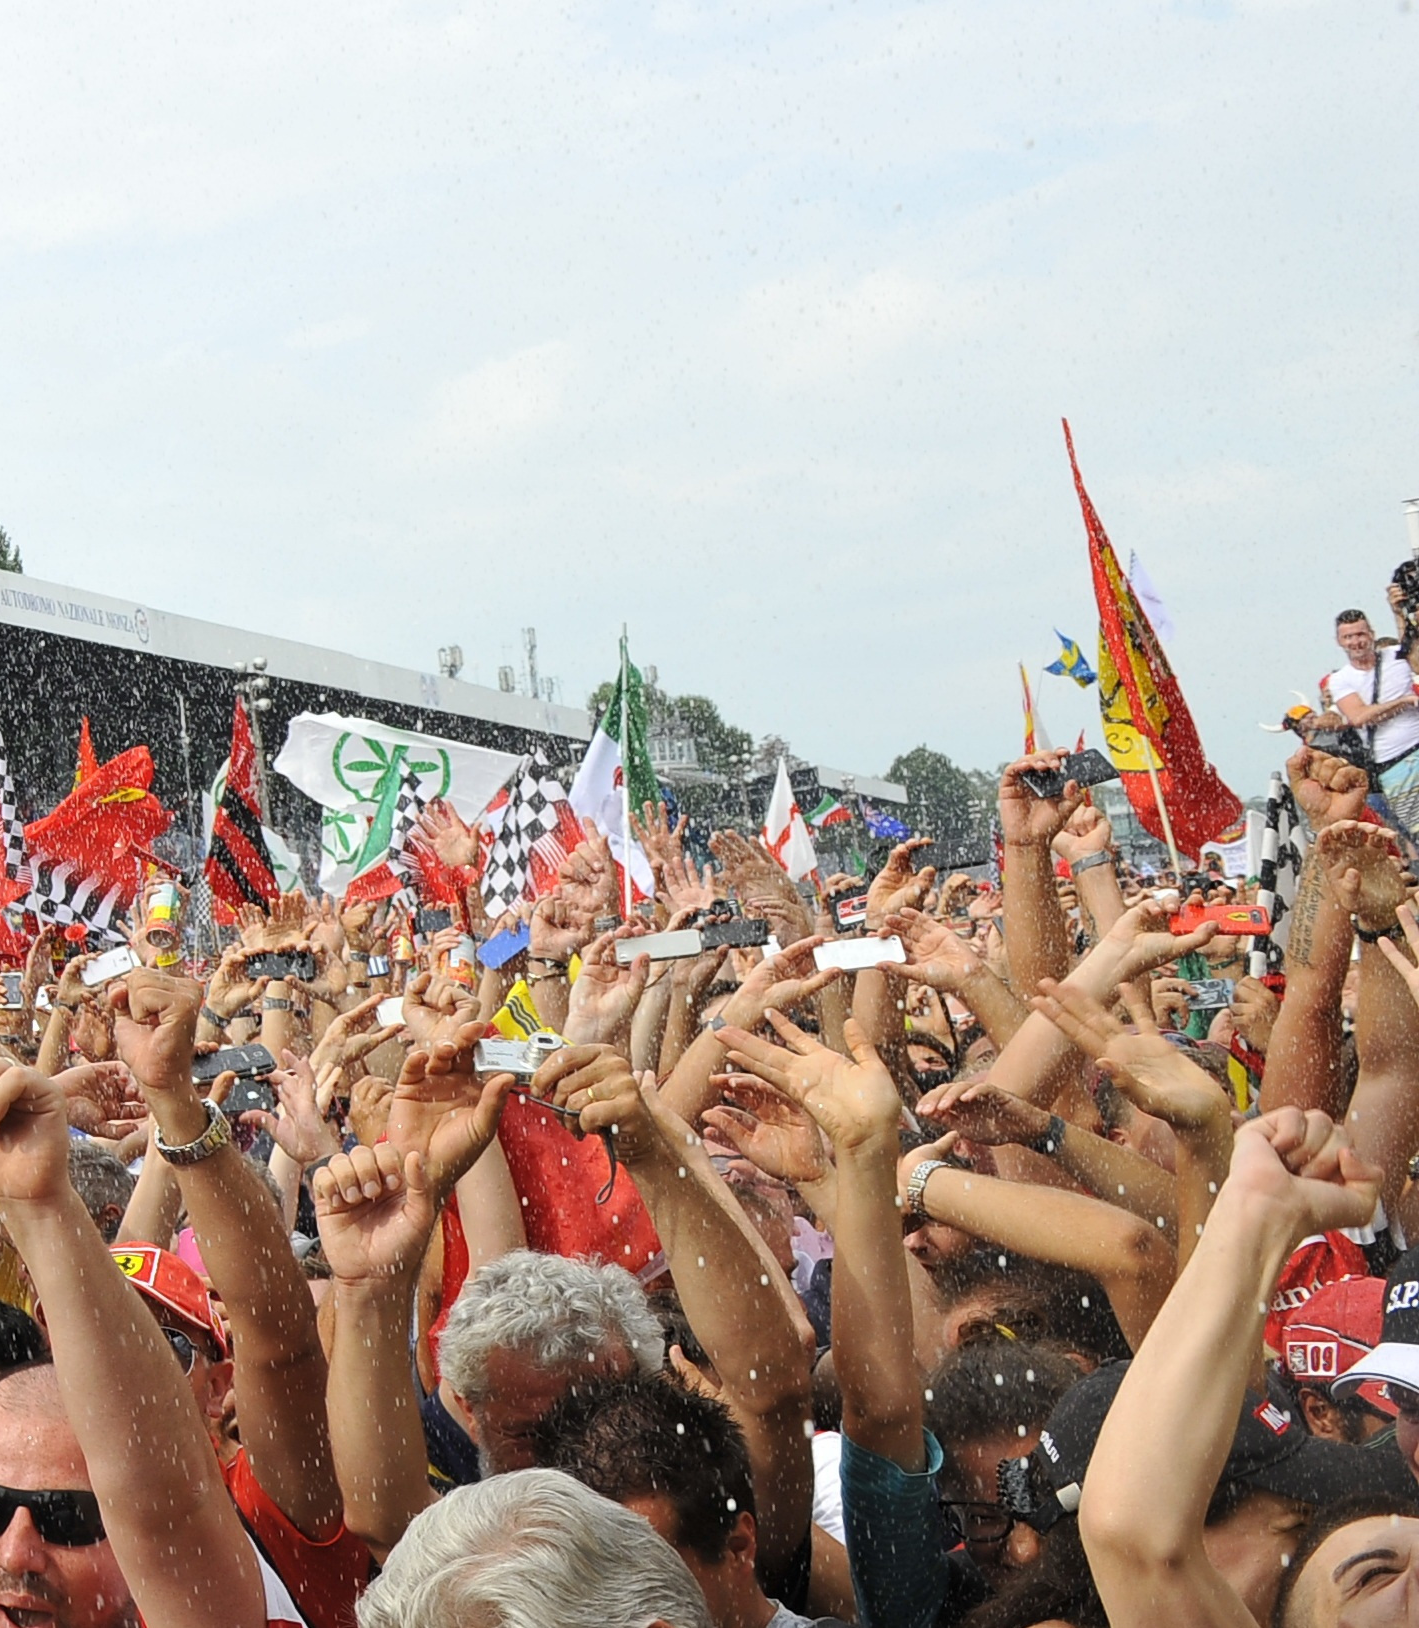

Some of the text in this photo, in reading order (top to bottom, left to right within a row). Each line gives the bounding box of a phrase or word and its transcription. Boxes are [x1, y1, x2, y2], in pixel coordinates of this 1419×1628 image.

[1, 588, 56, 616] AUTODROMO
[57, 600, 105, 626] NAZIONALE
[105, 611, 136, 633] MONZA
[1310, 1345, 1334, 1372] 09
